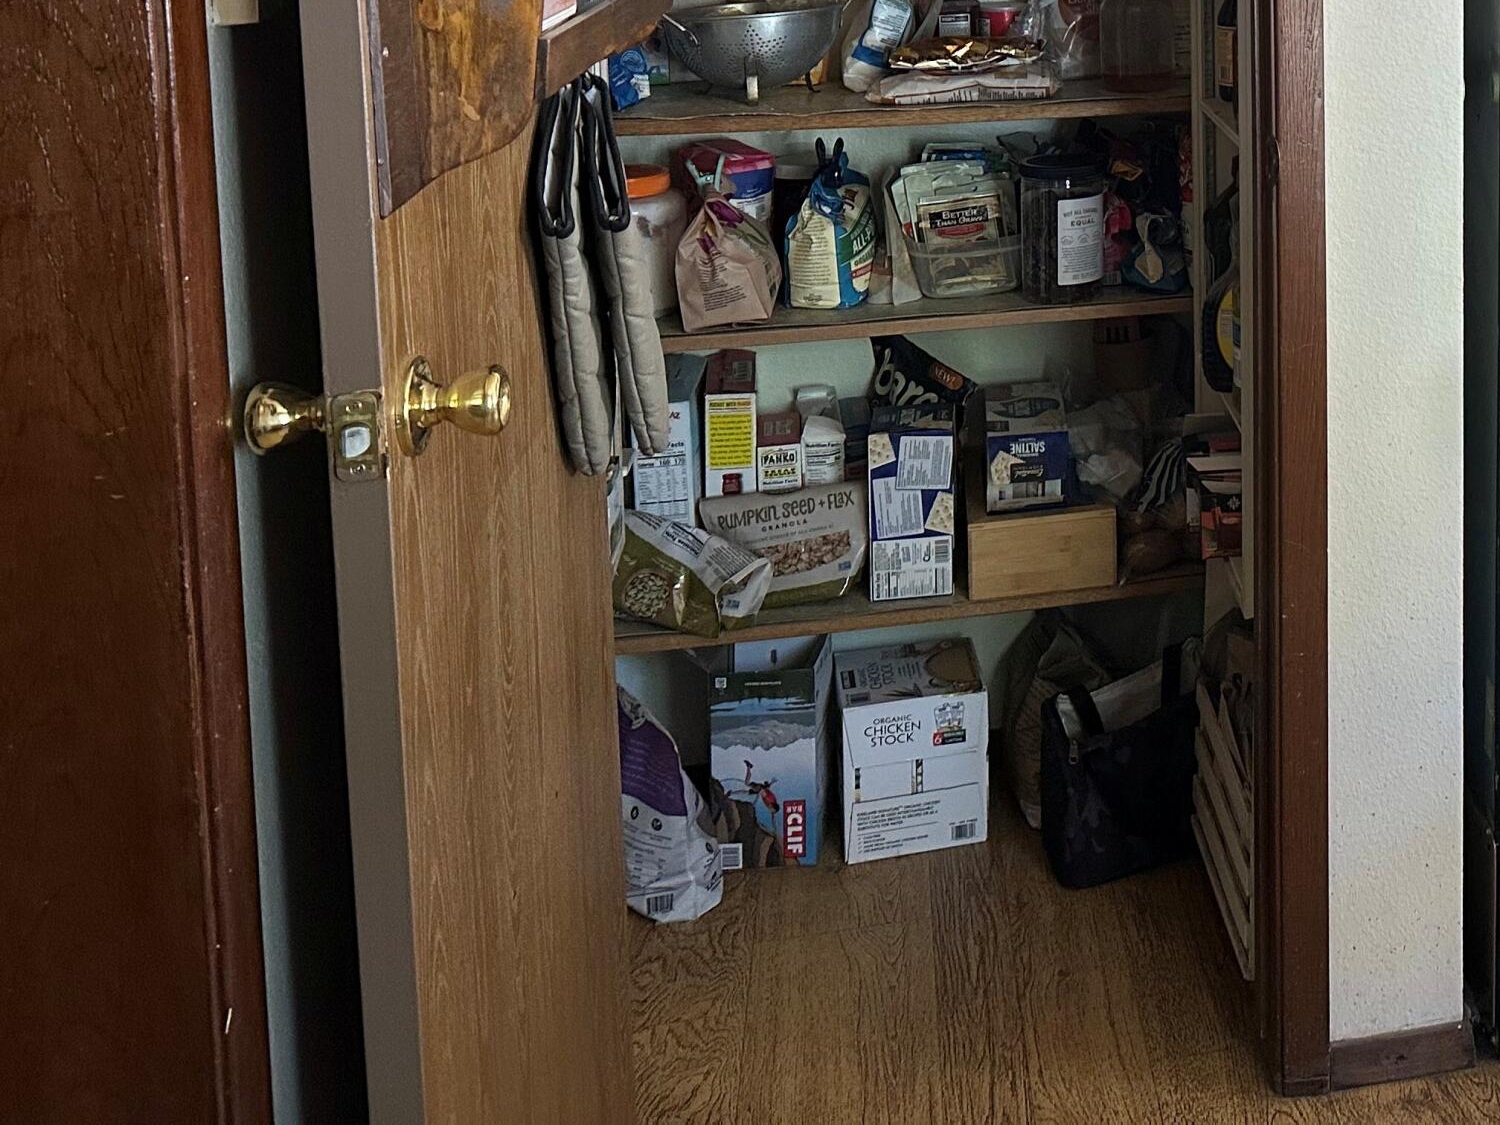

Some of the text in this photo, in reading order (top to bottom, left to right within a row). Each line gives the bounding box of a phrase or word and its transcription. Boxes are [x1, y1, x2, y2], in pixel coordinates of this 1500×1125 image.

[936, 219, 957, 228] THAN
[1010, 441, 1045, 454] SALTINE
[763, 453, 795, 465] PANKO
[761, 518, 808, 532] GRANOLA
[872, 714, 912, 725] ORGANIC
[864, 720, 921, 737] CHICKEN
[871, 732, 914, 748] STOCK
[786, 814, 803, 854] CLIF
